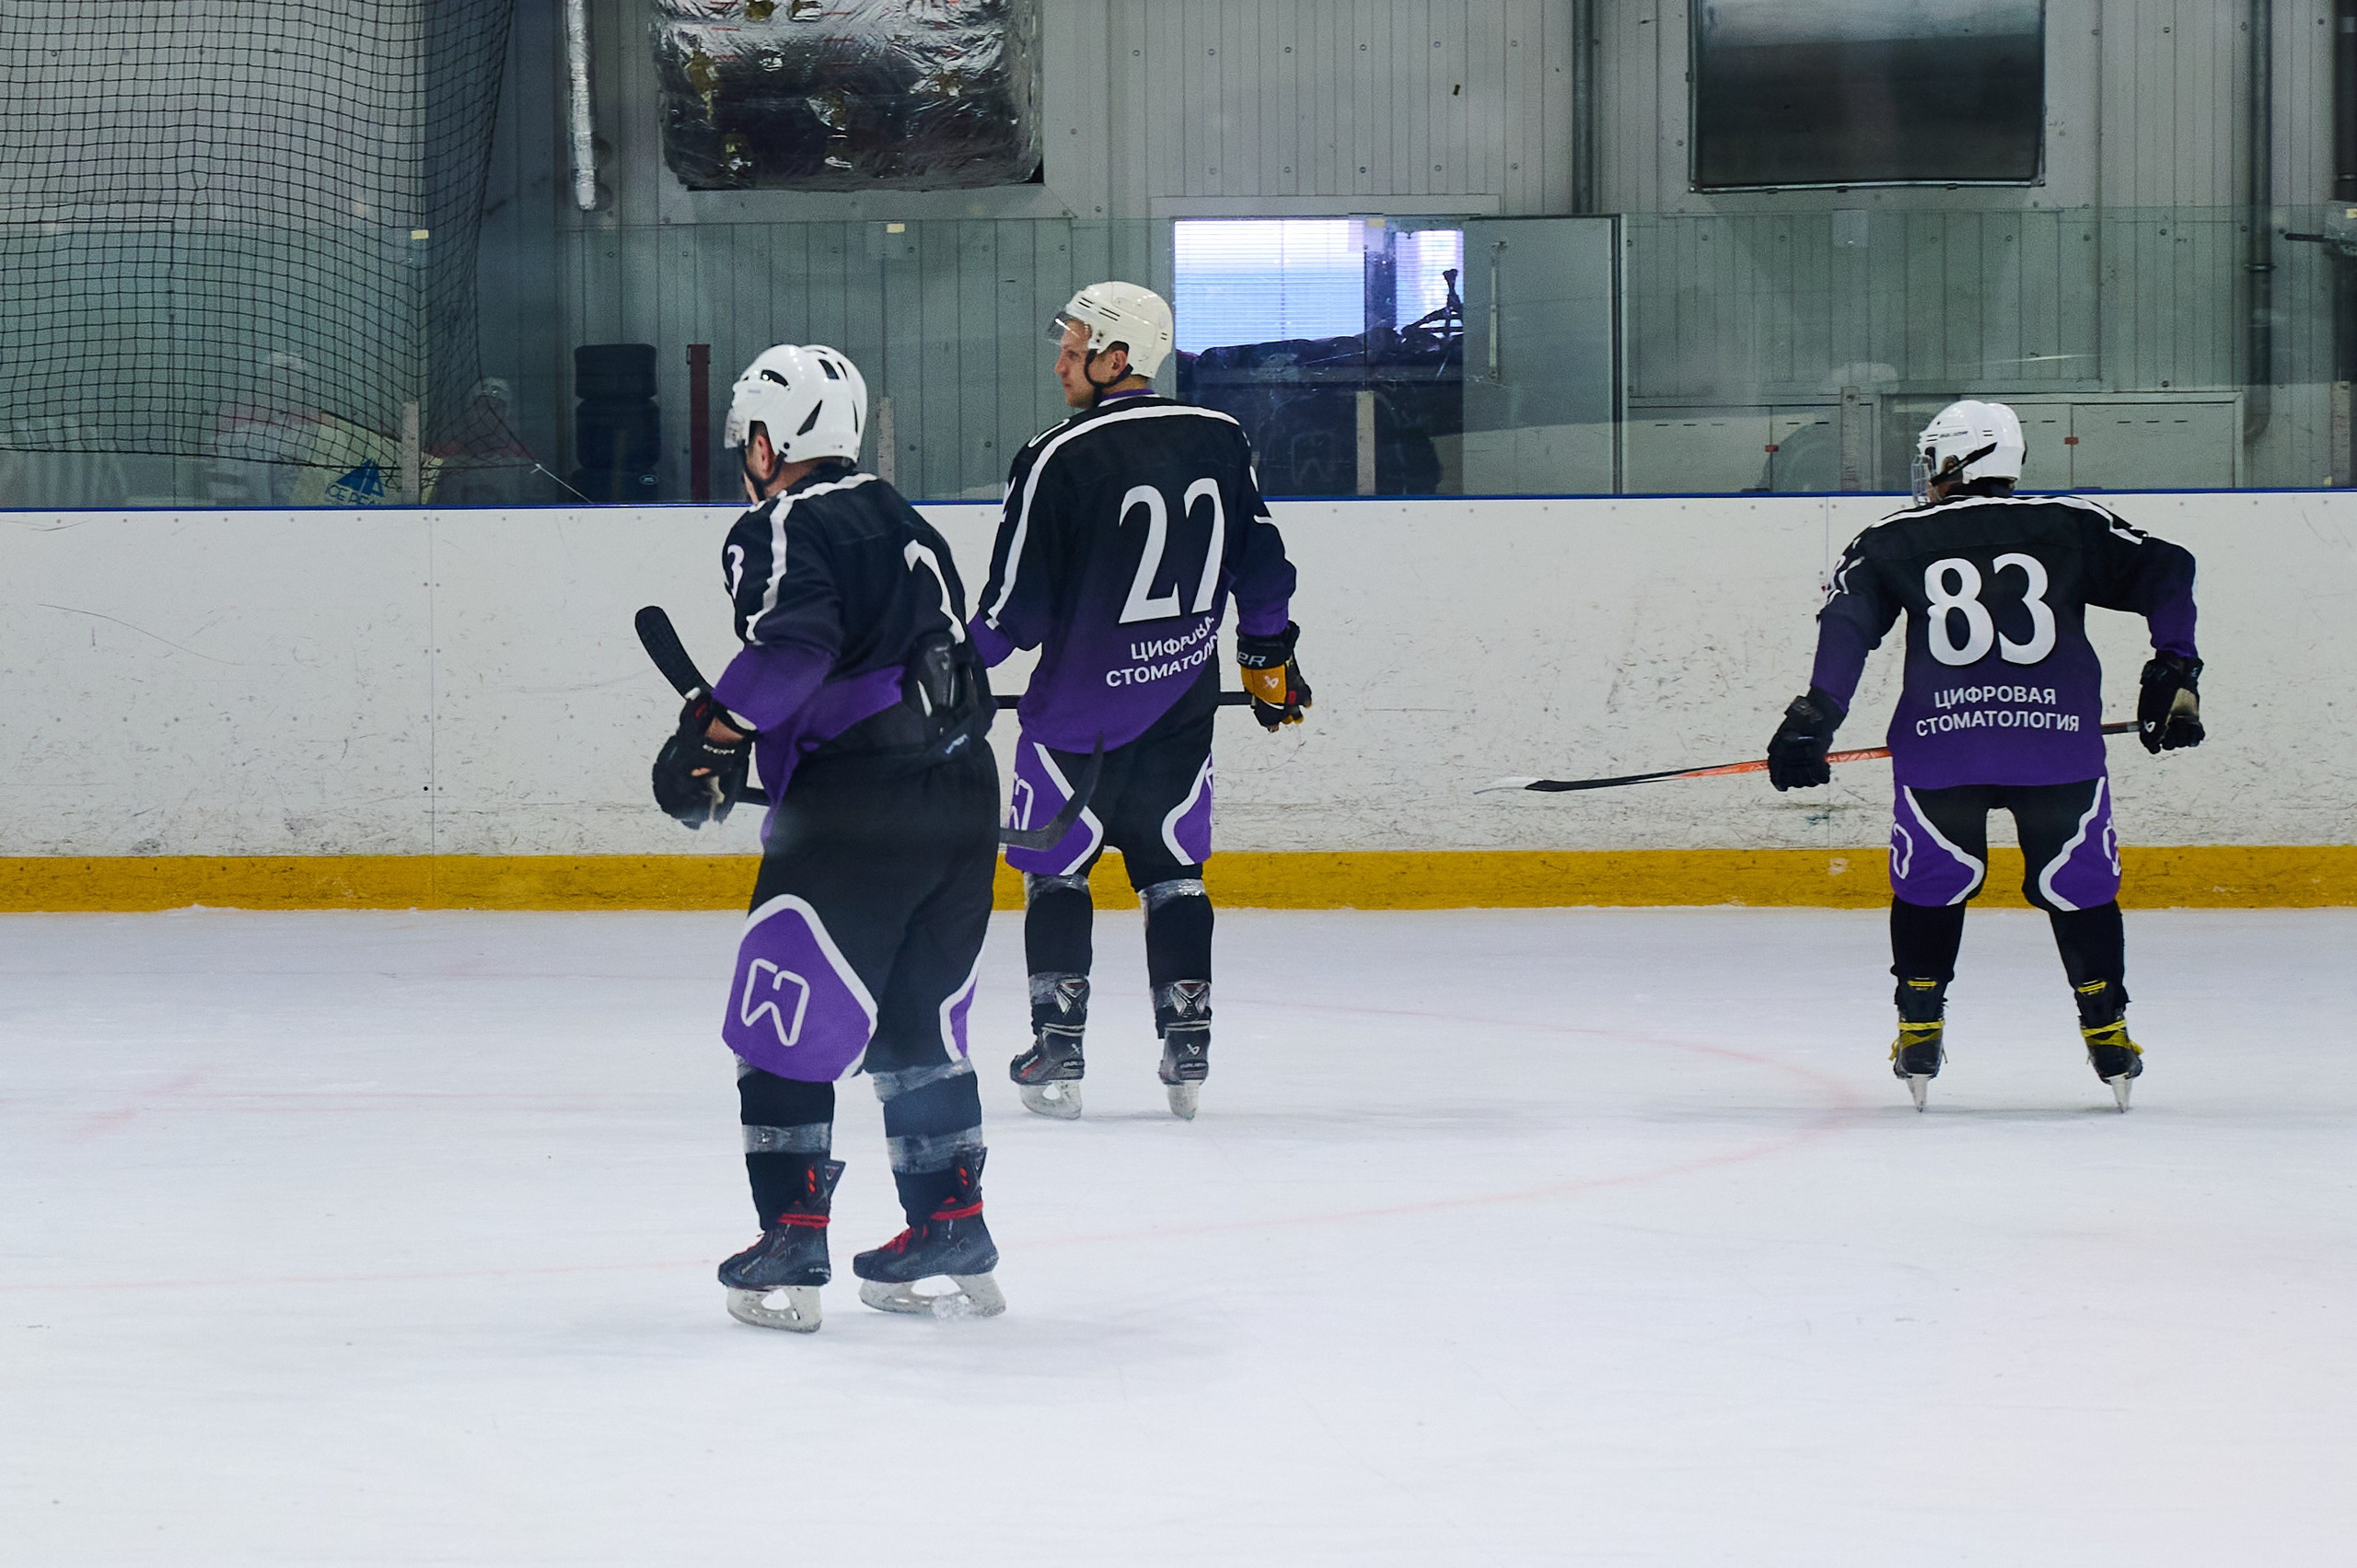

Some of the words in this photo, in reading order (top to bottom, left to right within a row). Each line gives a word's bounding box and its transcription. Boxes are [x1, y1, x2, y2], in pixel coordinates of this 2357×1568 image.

[1924, 552, 2057, 666] 83
[1934, 685, 2057, 710] ЦИФРОВАЯ
[1916, 710, 2080, 737] СТОМАТОЛОГИЯ
